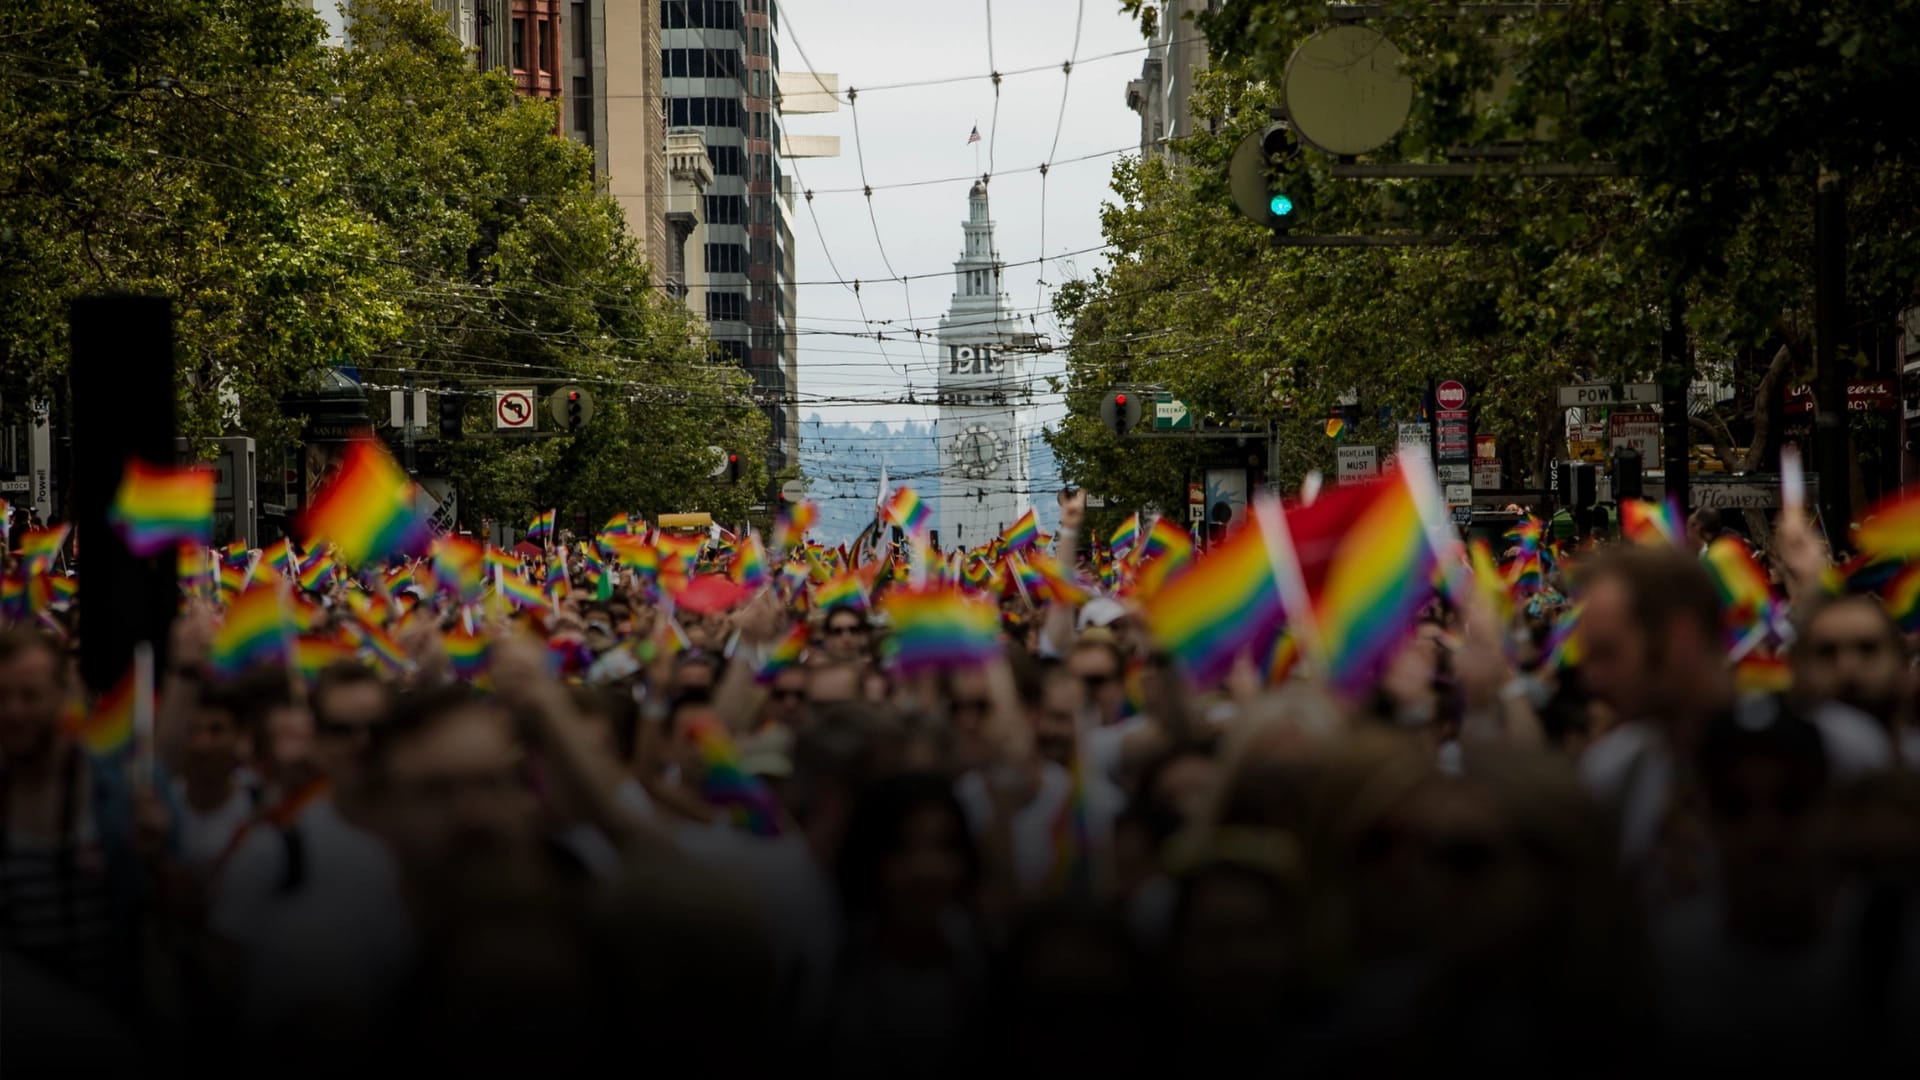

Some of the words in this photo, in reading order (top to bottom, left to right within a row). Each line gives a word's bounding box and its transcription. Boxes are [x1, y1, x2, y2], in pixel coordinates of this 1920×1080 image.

[1578, 388, 1638, 402] POWL
[1347, 461, 1368, 471] MUST
[6, 482, 28, 490] STOCK
[37, 470, 46, 503] Powell
[1698, 487, 1772, 508] Flowers
